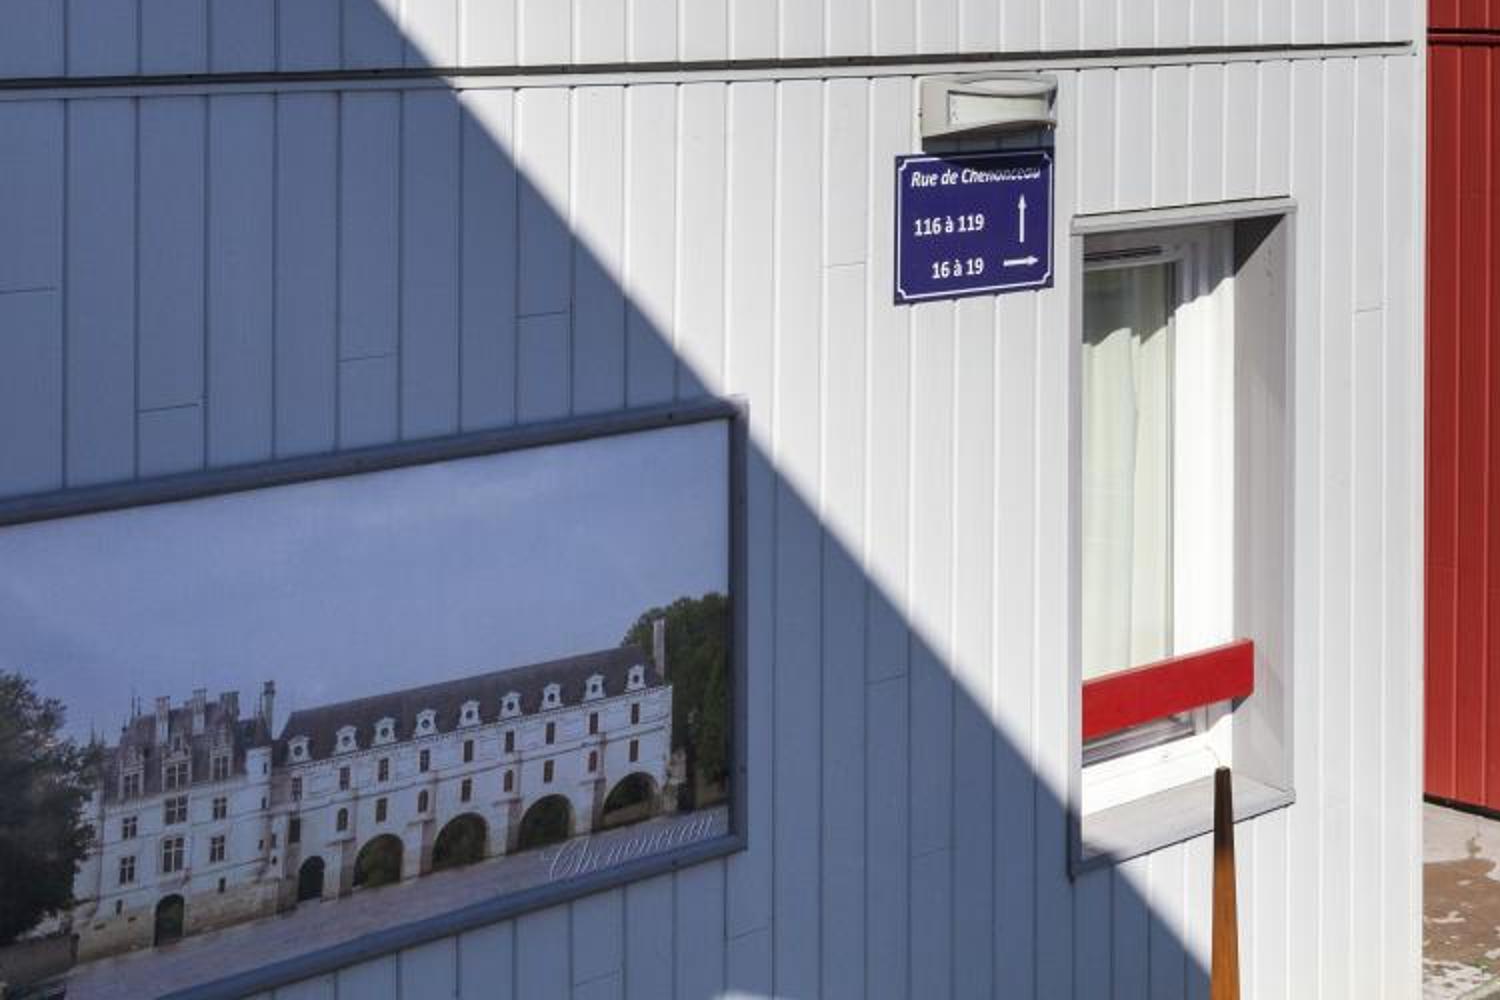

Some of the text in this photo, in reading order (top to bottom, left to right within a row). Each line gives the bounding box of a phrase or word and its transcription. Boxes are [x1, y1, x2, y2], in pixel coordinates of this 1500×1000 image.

[911, 171, 938, 188] Rue
[941, 168, 958, 185] de
[914, 213, 985, 236] 116 à 119
[932, 257, 985, 279] 16 à 19
